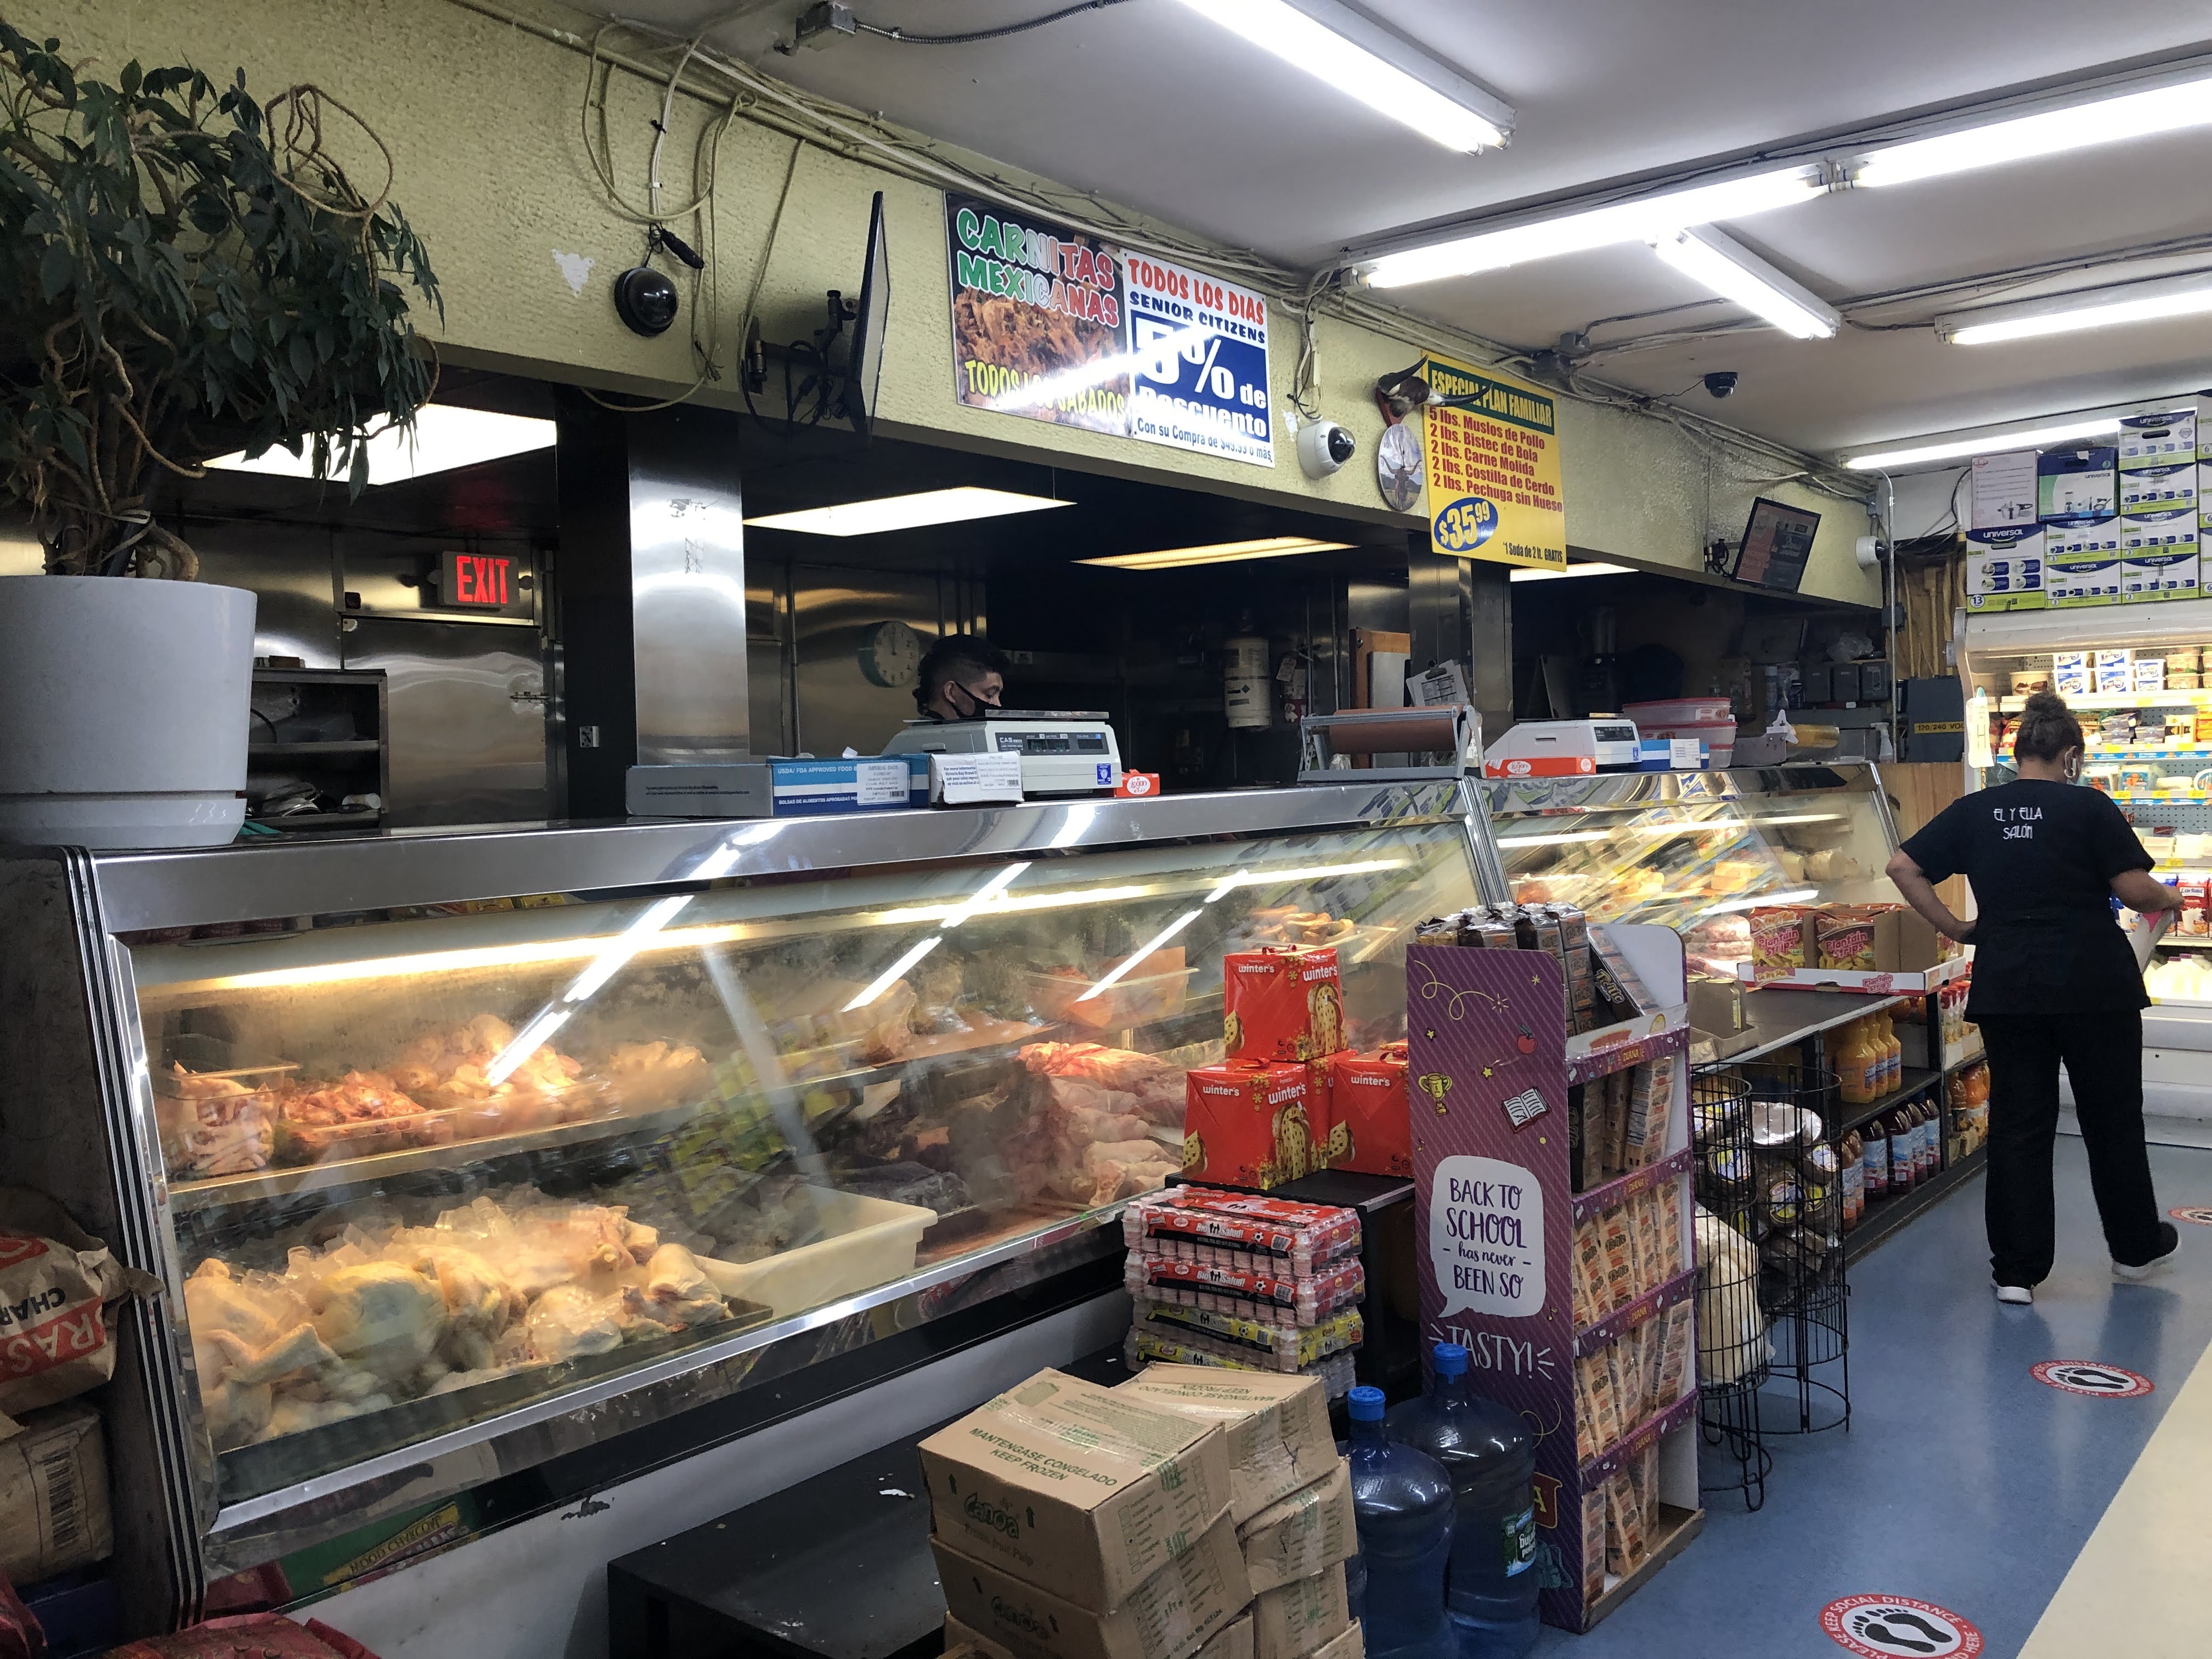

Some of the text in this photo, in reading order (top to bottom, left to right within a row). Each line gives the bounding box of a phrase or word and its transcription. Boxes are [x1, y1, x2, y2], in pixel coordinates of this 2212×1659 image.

[957, 208, 1114, 291] CARNITAS
[957, 250, 1119, 328] MEXICANAS
[1128, 259, 1263, 325] TODOS LOS DIAS
[1130, 291, 1265, 343] SENIOR CITIZENS
[1135, 317, 1266, 409] 5% de
[965, 359, 1019, 396] TODOS
[1482, 385, 1507, 414] PLAN
[1509, 394, 1552, 427] FAMILIAR
[1138, 417, 1155, 435] Con
[1159, 425, 1169, 438] su
[1172, 425, 1205, 446] Compra
[1207, 435, 1217, 448] de
[1429, 406, 1545, 449] 5 lbs. Muslos de Pollo
[2140, 415, 2172, 424] universal
[1430, 423, 1538, 463] 2 lbs. Bistec de Bola
[1431, 439, 1534, 476] 2 lbs. Carne Molida
[1432, 456, 1555, 495] 2 lbs. Costilla de Cerdo
[1433, 473, 1562, 512] 2 lbs. Pechuga sin Hueso
[1983, 529, 2023, 538] universal
[1509, 542, 1562, 563] Soda de 2 GRATIS
[456, 555, 509, 604] EXIT
[1972, 596, 1983, 605] 13
[1993, 806, 2042, 821] EL Y ELLA
[1758, 929, 1799, 948] Plantain
[1765, 941, 1795, 957] Strips
[1826, 930, 1868, 950] Plantain
[1833, 944, 1864, 959] Strips
[1238, 964, 1275, 973] winter's
[1303, 964, 1338, 981] winter's
[1863, 974, 1893, 988] Plantain
[1868, 981, 1891, 993] Strips
[1623, 1048, 1639, 1062] DIANA
[1203, 1086, 1240, 1097] winter's
[1268, 1082, 1306, 1104] winter's
[1351, 1075, 1390, 1086] winter's
[1449, 1178, 1523, 1210] BACK TO
[1220, 1227, 1244, 1239] Salud!
[1446, 1207, 1527, 1249] SCHOOL
[1458, 1241, 1516, 1267] has never
[1221, 1274, 1246, 1288] Salud!
[1453, 1264, 1523, 1299] BEEN SO
[7, 1305, 102, 1372] RAS
[1446, 1325, 1532, 1380] TASTY!
[968, 1427, 1118, 1486] MANTENGASE CONGELADO
[990, 1449, 1069, 1481] KEEP FROZEN
[1830, 1596, 1880, 1613] SOCIAL
[1882, 1596, 1963, 1623] DISTANCE
[1824, 1611, 1839, 1632] KEEP
[1963, 1631, 1980, 1654] HERE
